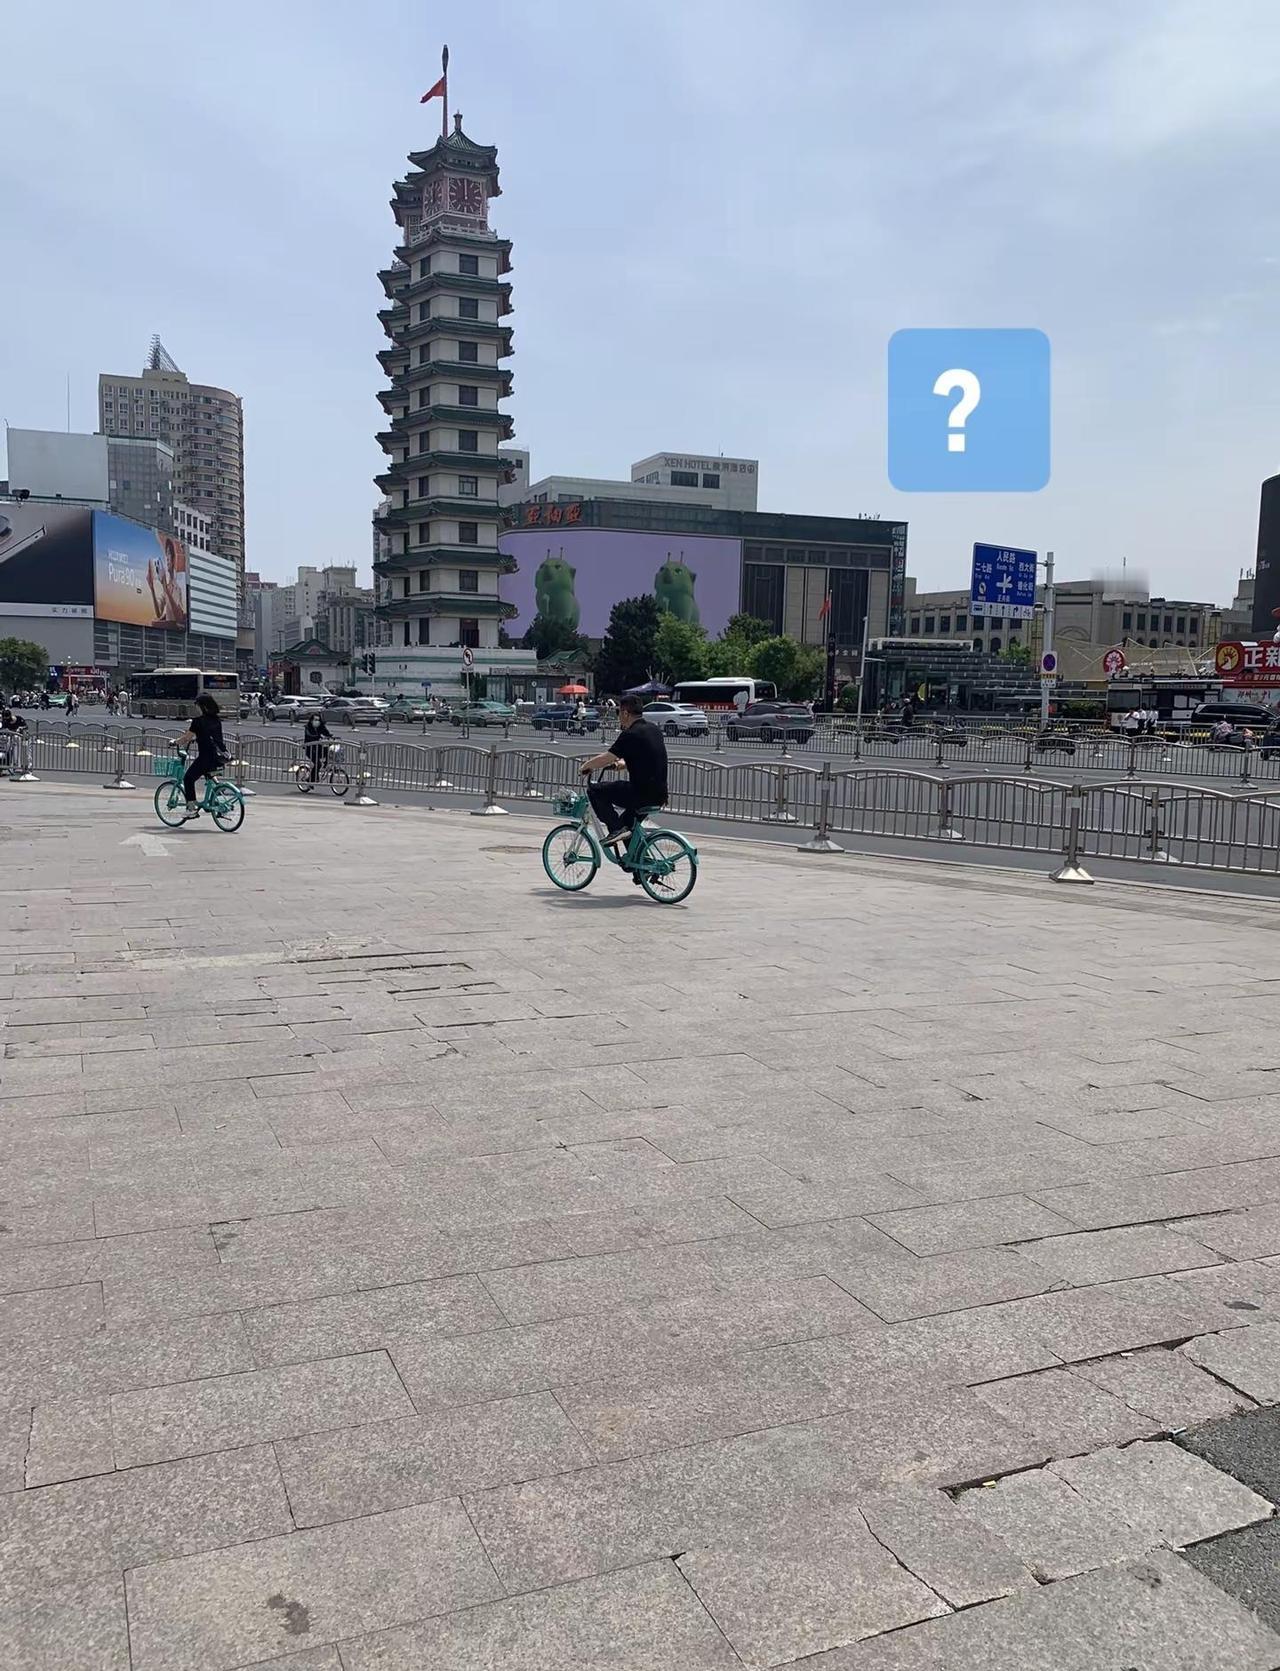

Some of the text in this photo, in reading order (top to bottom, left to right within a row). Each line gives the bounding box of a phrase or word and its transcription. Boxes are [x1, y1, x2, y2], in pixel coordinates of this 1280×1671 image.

[684, 459, 711, 471] HOTEL
[996, 551, 1016, 563] 人民路
[975, 562, 992, 573] 二七路
